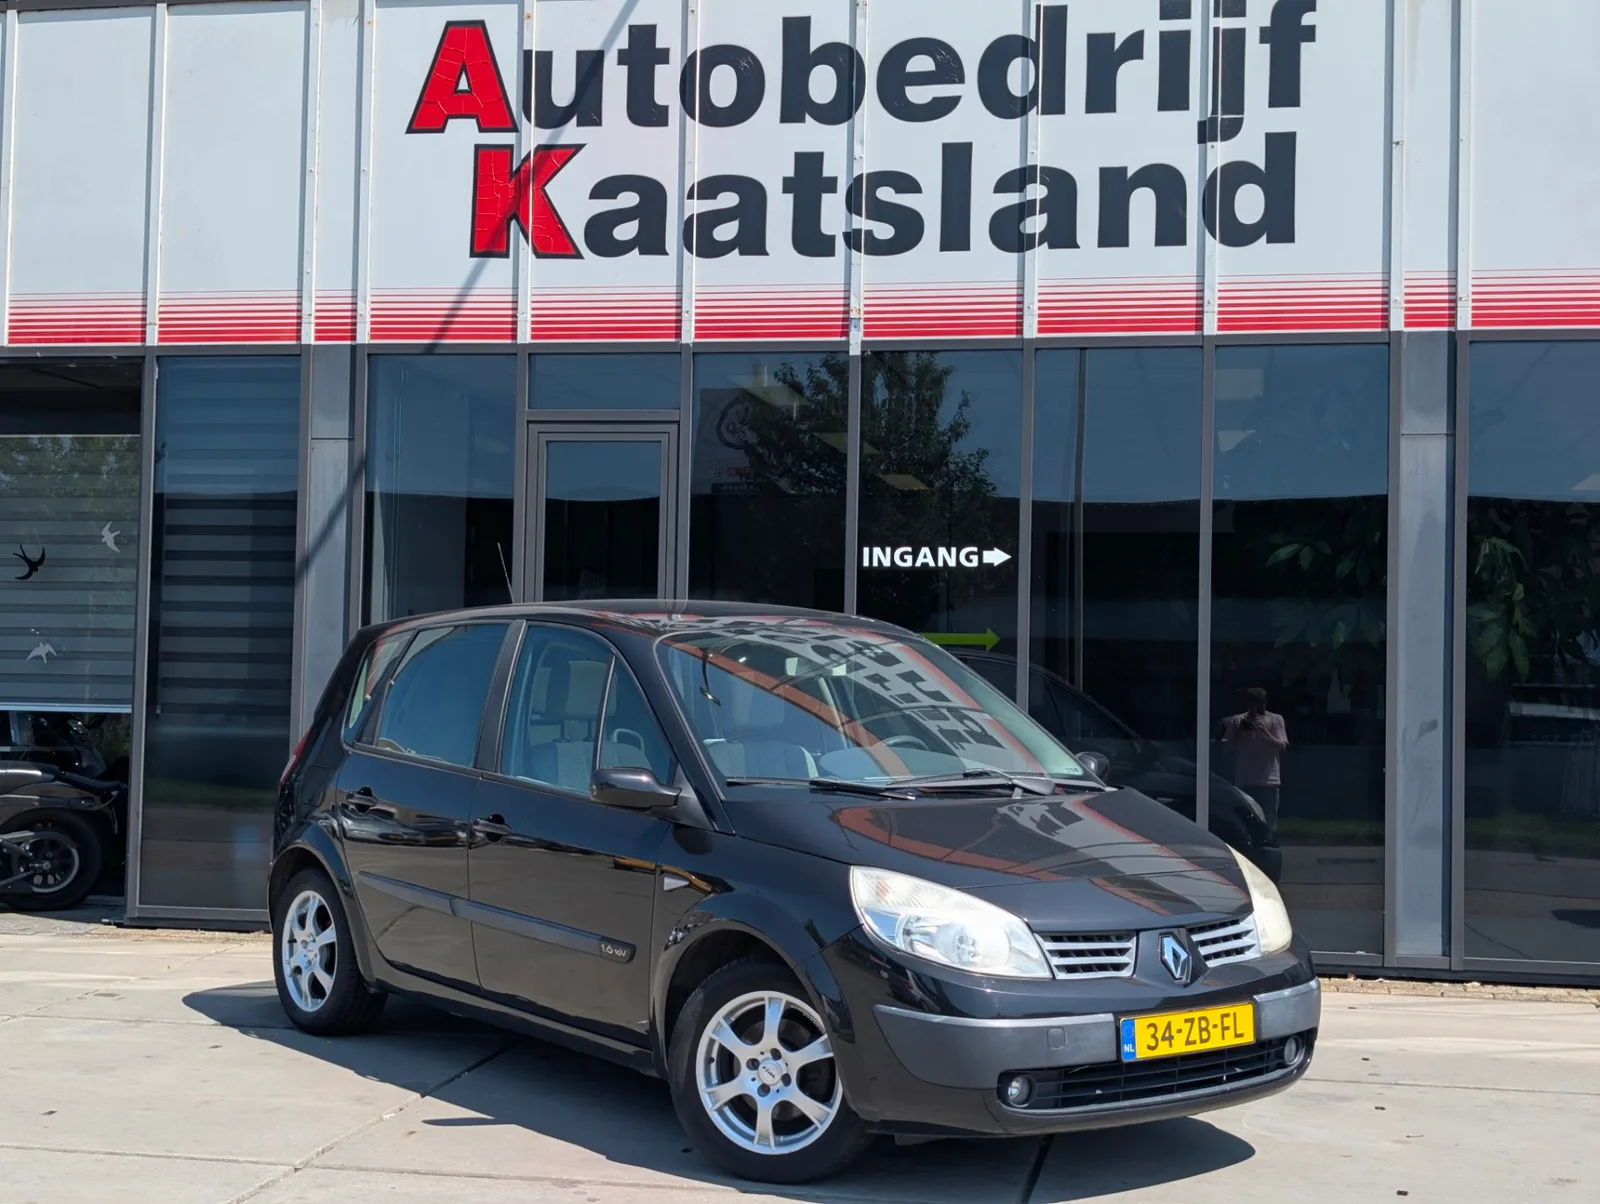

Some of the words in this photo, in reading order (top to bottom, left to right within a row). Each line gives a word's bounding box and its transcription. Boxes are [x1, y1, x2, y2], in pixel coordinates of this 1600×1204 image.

[405, 0, 1317, 144] Autobedrijf
[469, 131, 1297, 259] Kaatsland
[862, 546, 979, 568] INGANG
[1124, 1044, 1134, 1053] NL
[1146, 1012, 1244, 1051] 34-ZB-FL
